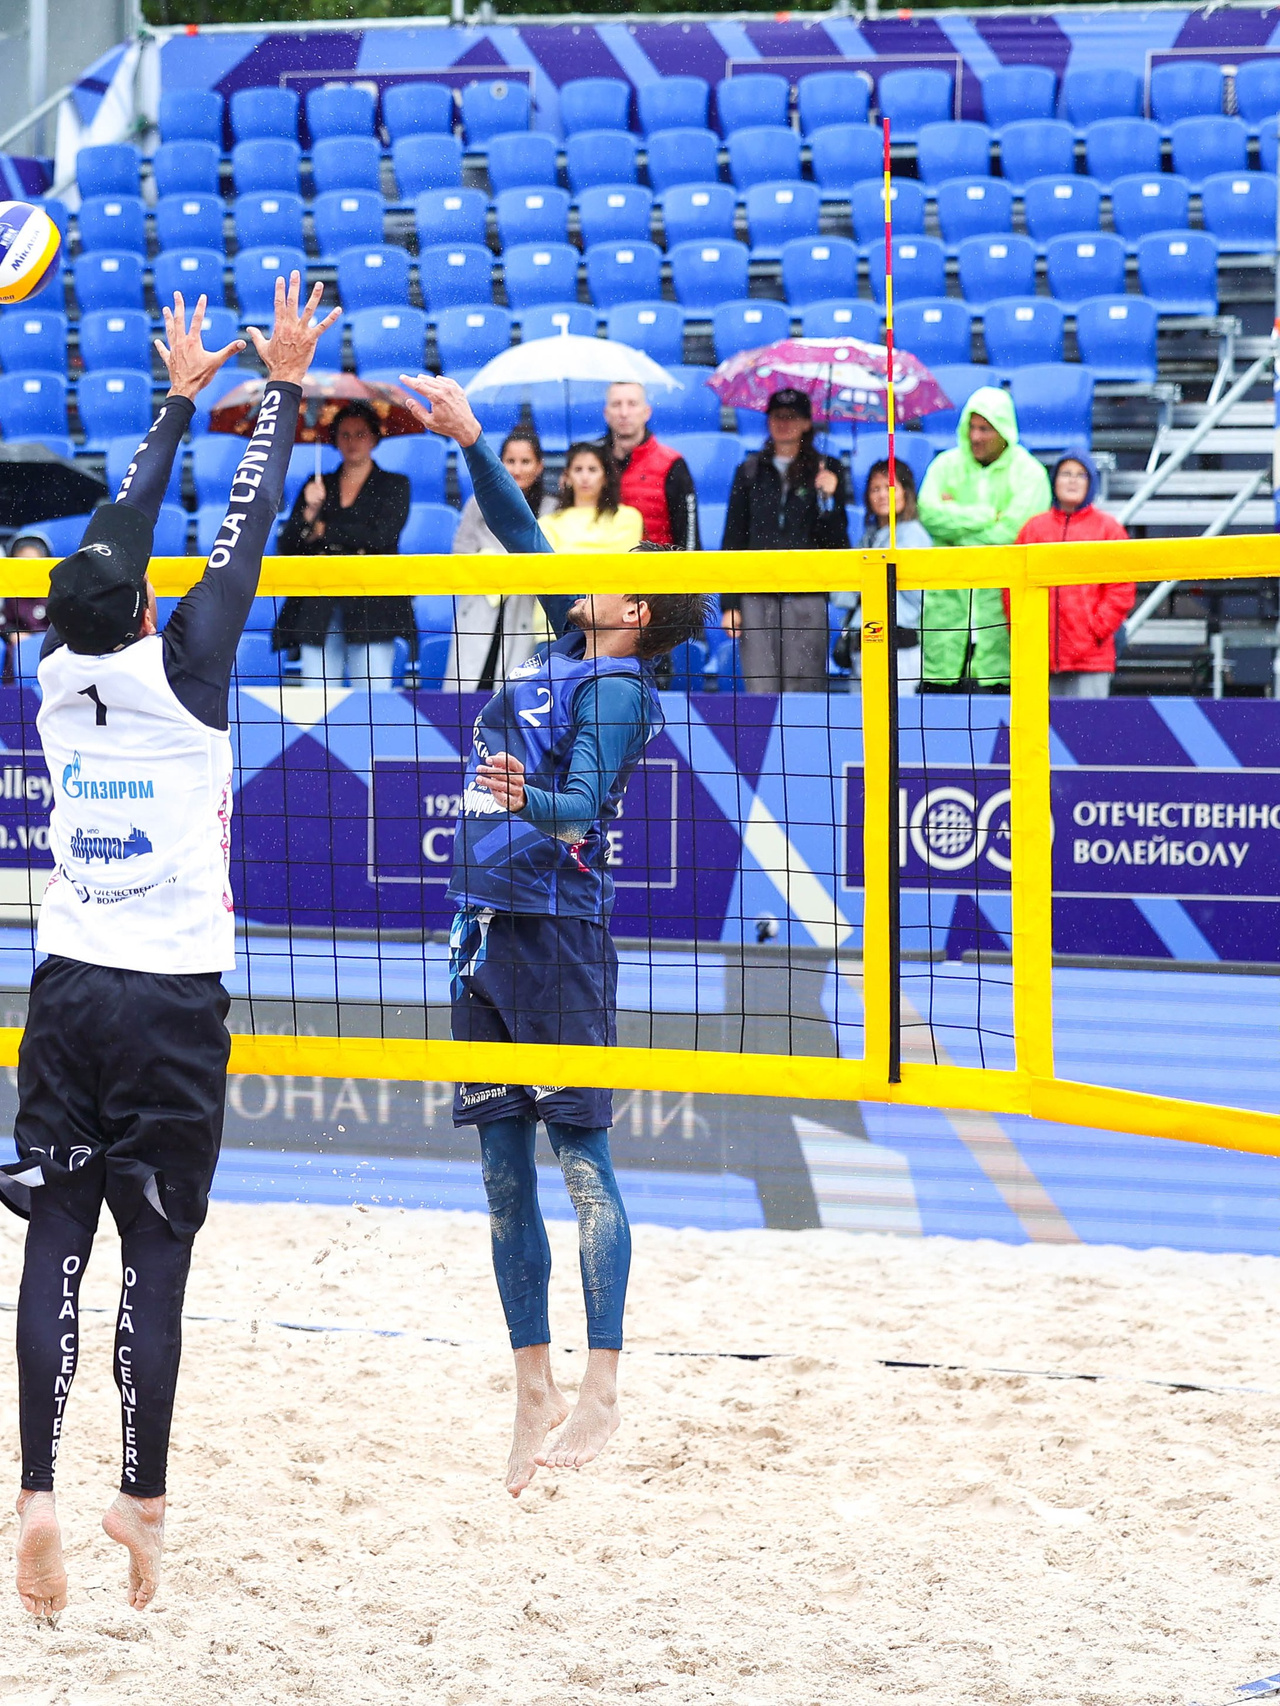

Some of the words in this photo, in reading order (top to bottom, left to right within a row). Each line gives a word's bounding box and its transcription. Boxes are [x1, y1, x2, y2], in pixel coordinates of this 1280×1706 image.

[208, 513, 246, 569] OLA
[229, 390, 281, 504] CENTERS
[77, 684, 107, 726] 1
[518, 687, 554, 727] 2
[82, 780, 154, 800] ГАЗПРОМ
[1073, 835, 1250, 868] ВОЛЕЙБОЛУ
[58, 1255, 80, 1320] OLA
[118, 1266, 137, 1334] OLA
[117, 1345, 140, 1483] CENTERS
